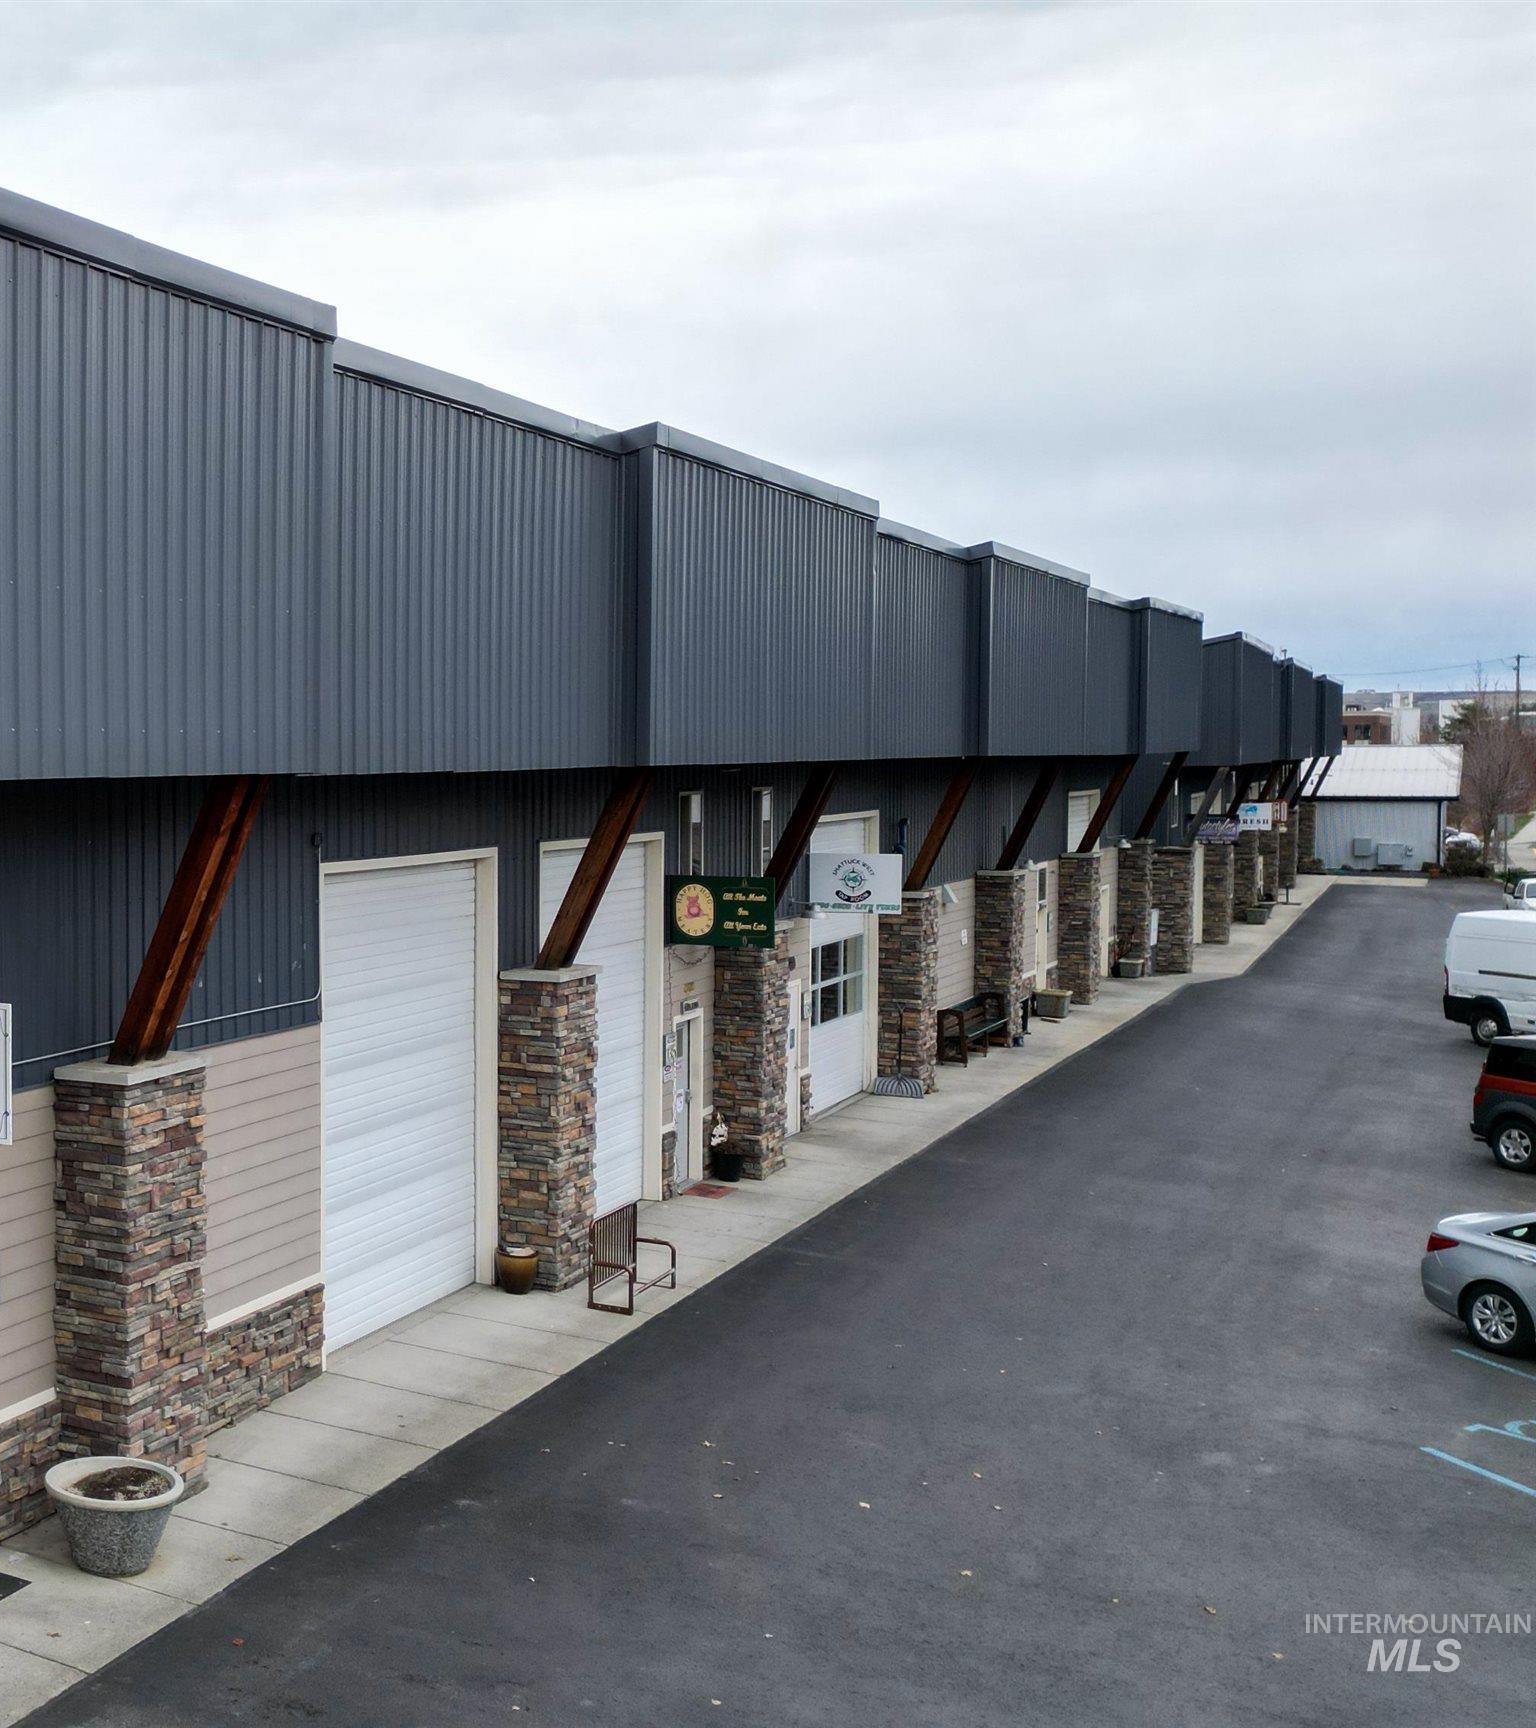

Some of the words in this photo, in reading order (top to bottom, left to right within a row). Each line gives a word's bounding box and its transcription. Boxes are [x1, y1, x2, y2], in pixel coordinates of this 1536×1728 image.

[832, 858, 861, 876] SHATTUCK
[676, 885, 697, 904] HAPPY
[699, 887, 713, 905] HOG
[838, 891, 849, 900] TAP
[850, 892, 870, 902] ROOM
